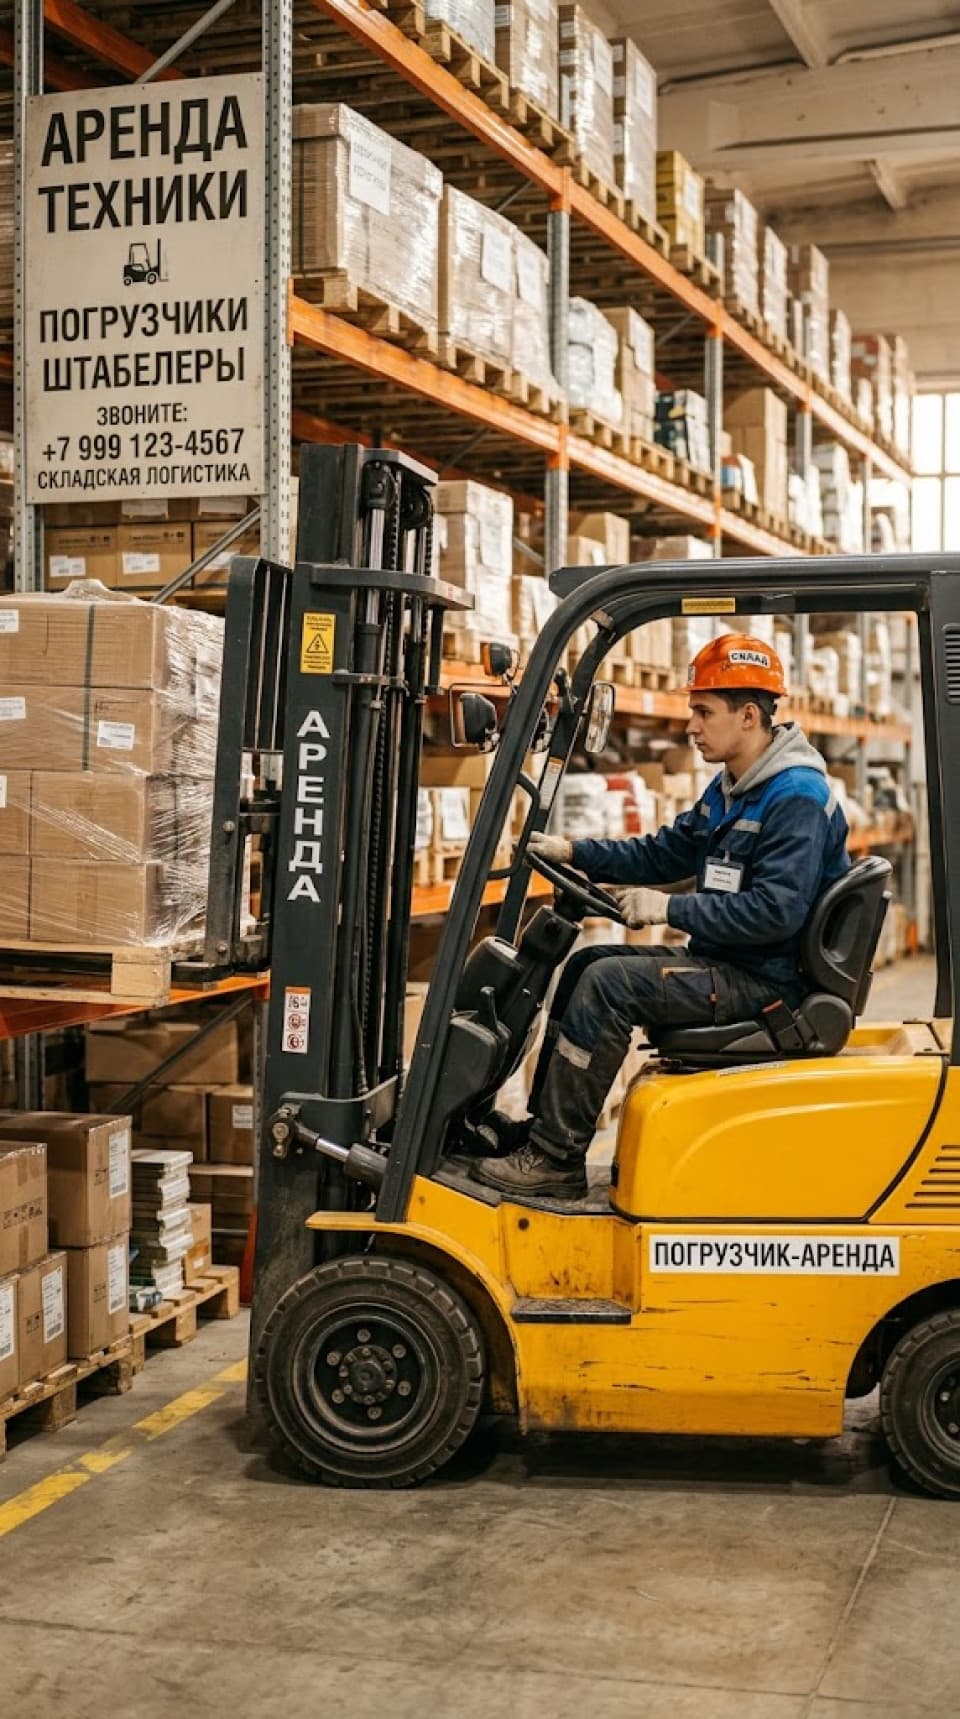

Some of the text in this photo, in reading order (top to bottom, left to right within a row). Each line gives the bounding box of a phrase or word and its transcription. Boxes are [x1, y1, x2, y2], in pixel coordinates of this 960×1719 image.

[41, 96, 248, 167] АРЕНДА
[38, 169, 248, 233] ТЕХНИКИ
[39, 297, 248, 343] ПОГРУЗЧИКИ
[43, 347, 245, 392] ШТАБЕЛЕРЫ
[96, 402, 188, 426] ЗВОНИТЕ:
[42, 428, 245, 462] +7 999 123-4567
[37, 463, 251, 490] СКЛАДСКАЯ ЛОГИСТИКА
[286, 709, 331, 903] АРЕНДА
[654, 1241, 895, 1271] ПОГРУЗЧИК-АРЕНДА
